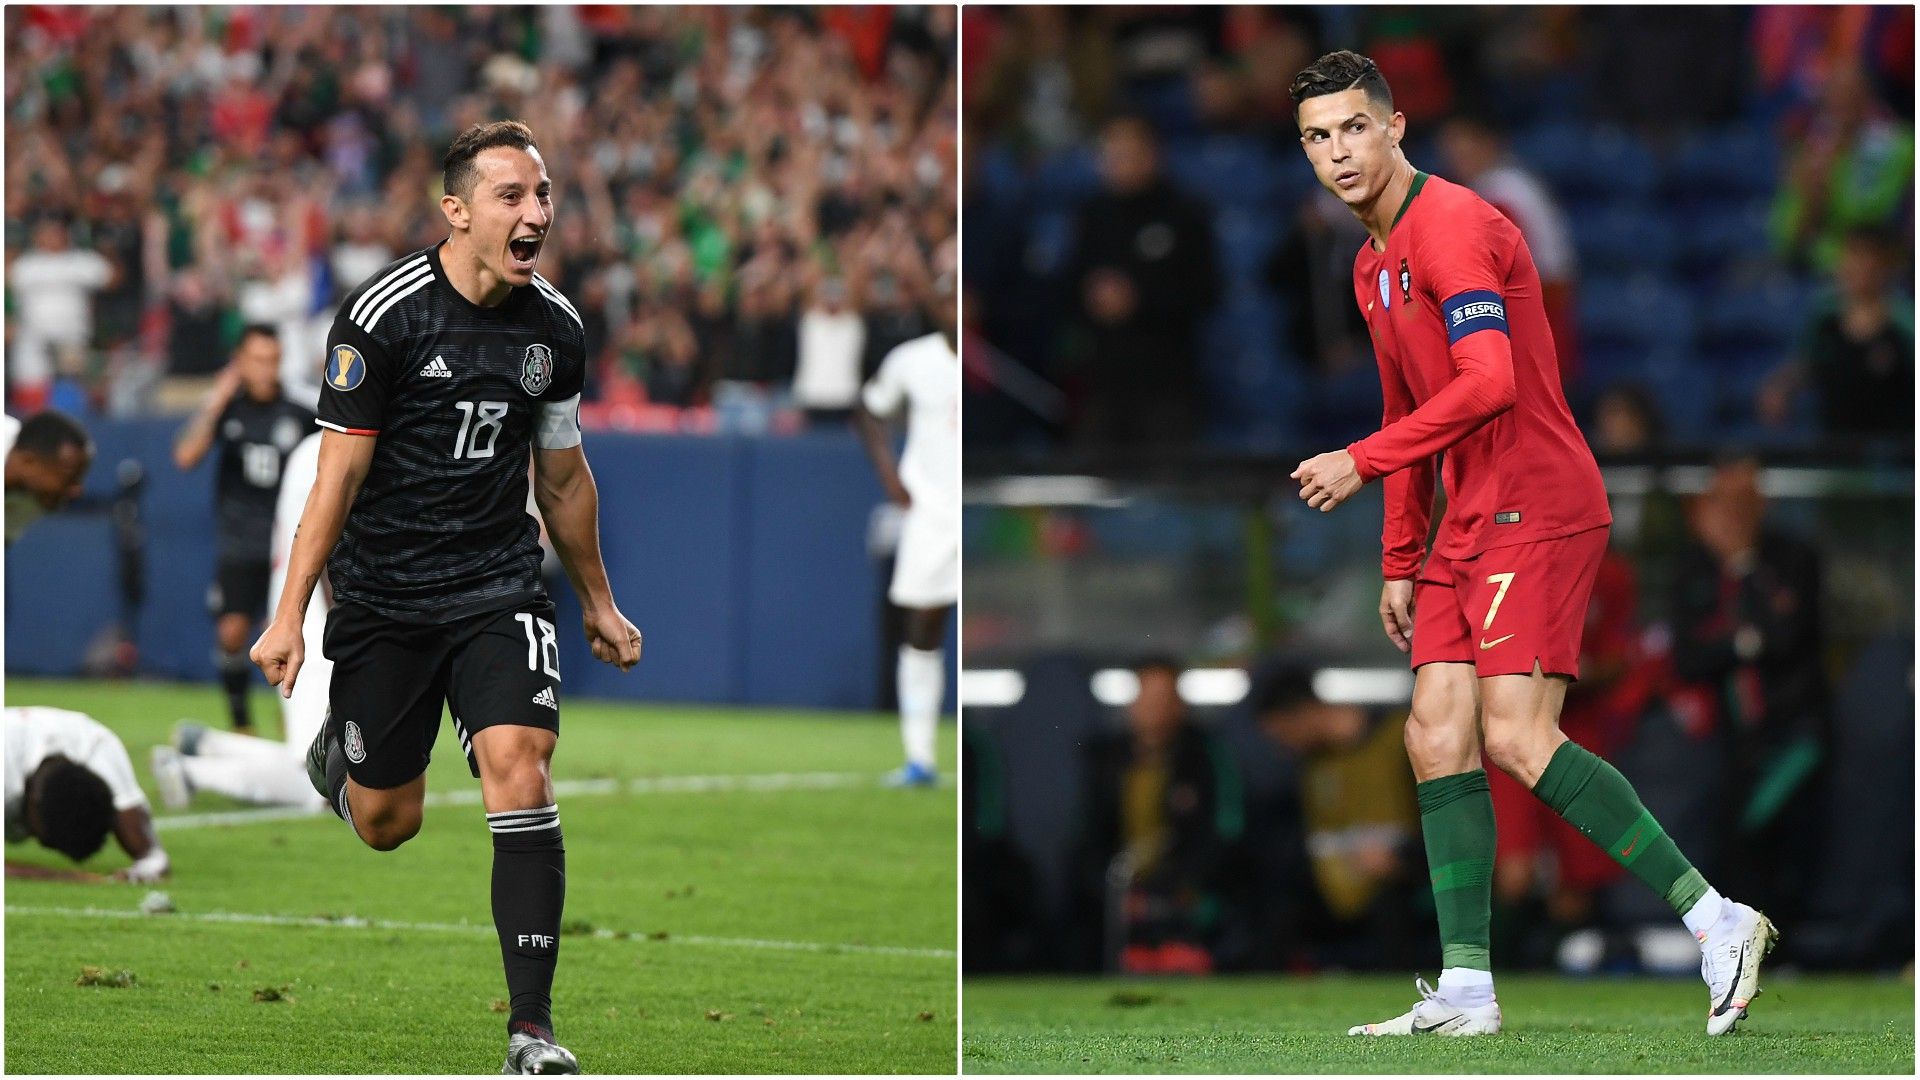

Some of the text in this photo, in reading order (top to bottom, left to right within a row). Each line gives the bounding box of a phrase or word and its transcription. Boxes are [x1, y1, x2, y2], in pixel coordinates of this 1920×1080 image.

[1464, 304, 1504, 317] RESPECT
[420, 368, 452, 378] adidas
[453, 400, 508, 460] 18
[1482, 571, 1516, 631] 7
[514, 612, 562, 683] 18
[532, 696, 558, 711] adidas
[517, 934, 554, 948] FMF
